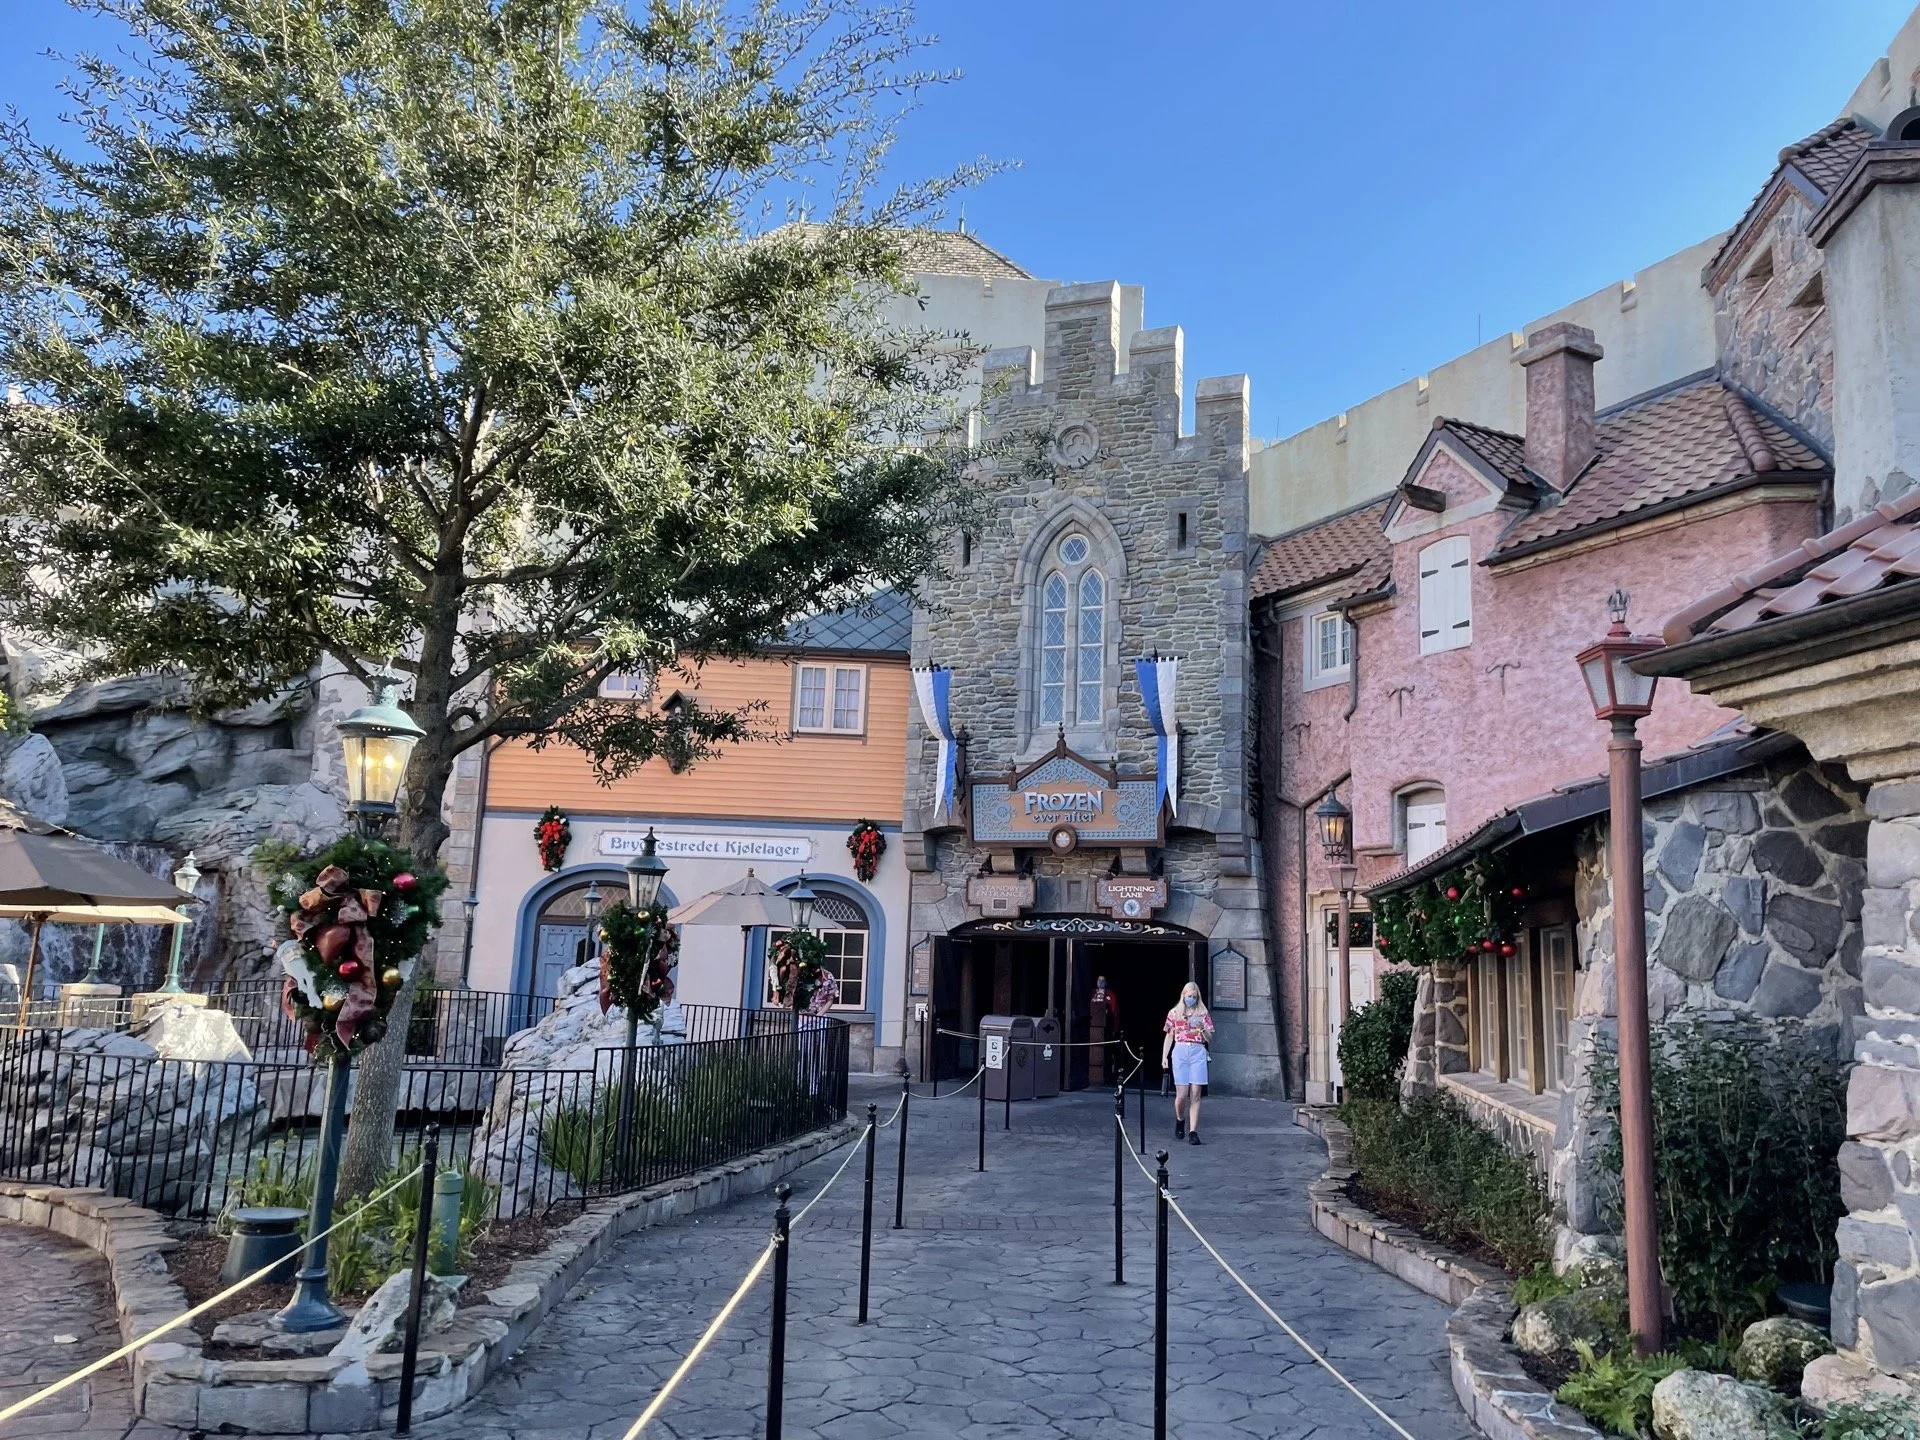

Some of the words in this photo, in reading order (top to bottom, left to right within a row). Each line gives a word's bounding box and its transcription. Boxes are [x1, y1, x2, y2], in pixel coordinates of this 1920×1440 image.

[1024, 790, 1104, 815] FROZEN
[1033, 812, 1060, 823] ever
[1065, 811, 1096, 823] after
[611, 837, 719, 852] Bryestredet
[725, 840, 800, 856] Kjølelager
[976, 890, 1024, 898] ENTRANCE
